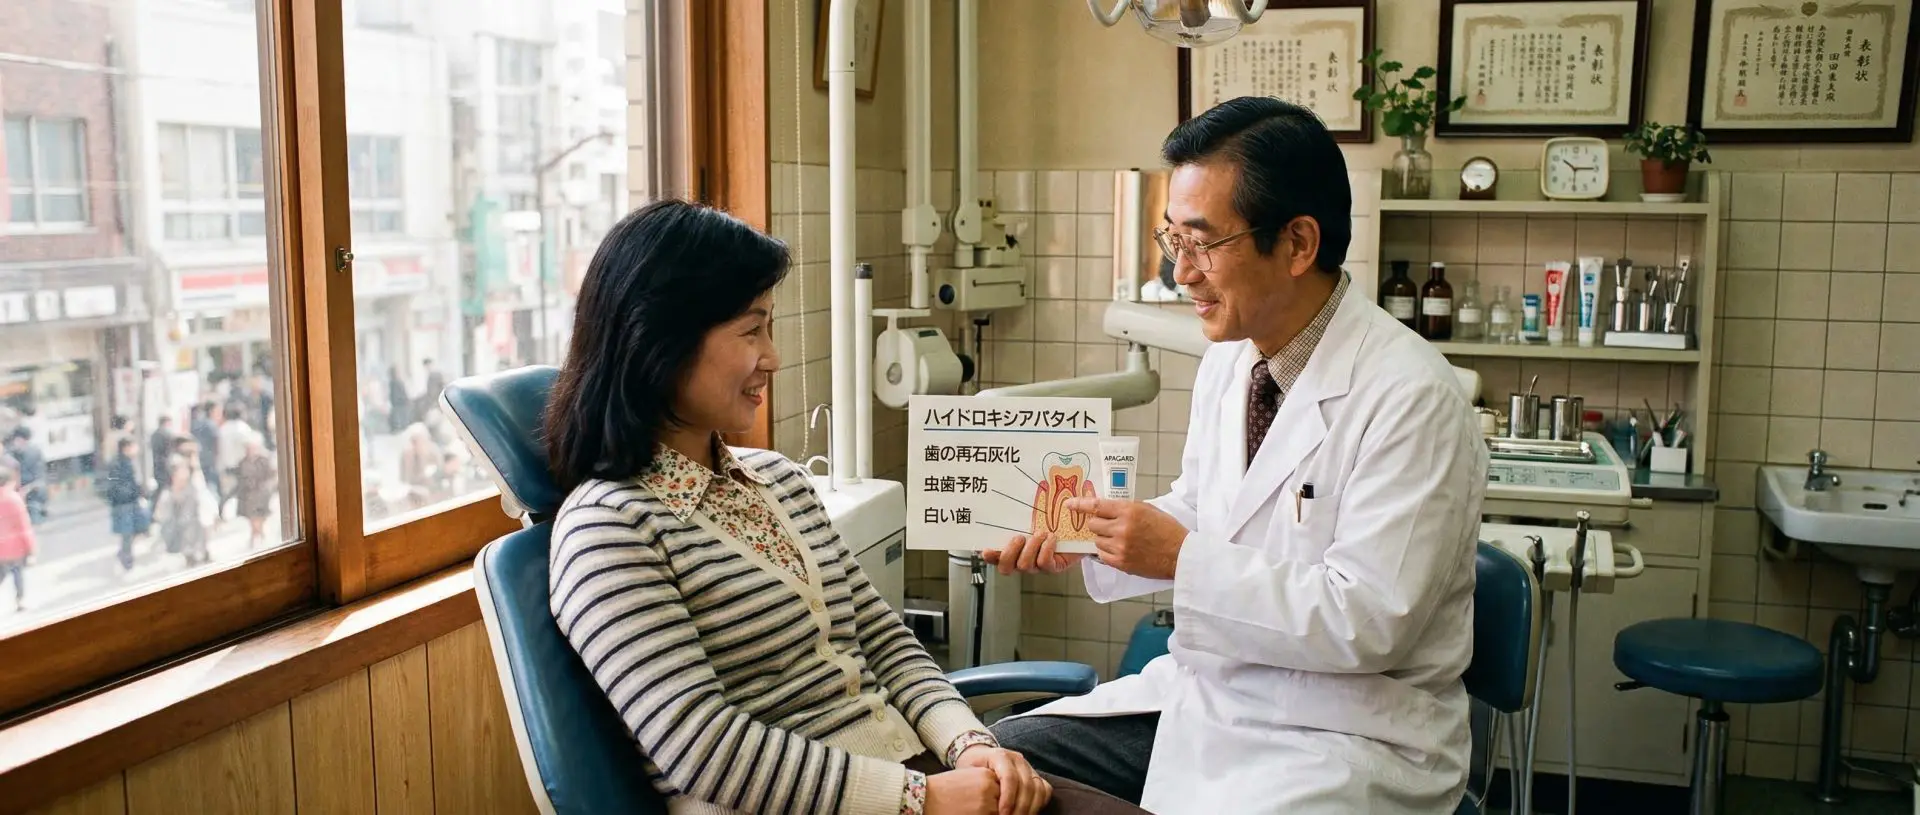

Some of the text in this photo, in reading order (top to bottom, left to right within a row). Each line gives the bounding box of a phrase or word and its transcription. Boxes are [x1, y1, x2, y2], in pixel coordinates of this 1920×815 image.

[1591, 44, 1604, 85] 表彰状
[1855, 39, 1872, 82] 表彰状
[924, 408, 1096, 429] ハイドロキシアパタイト
[924, 445, 1020, 463] 歯の再石灰化
[924, 476, 988, 493] 虫歯予防
[924, 507, 971, 524] 白い歯
